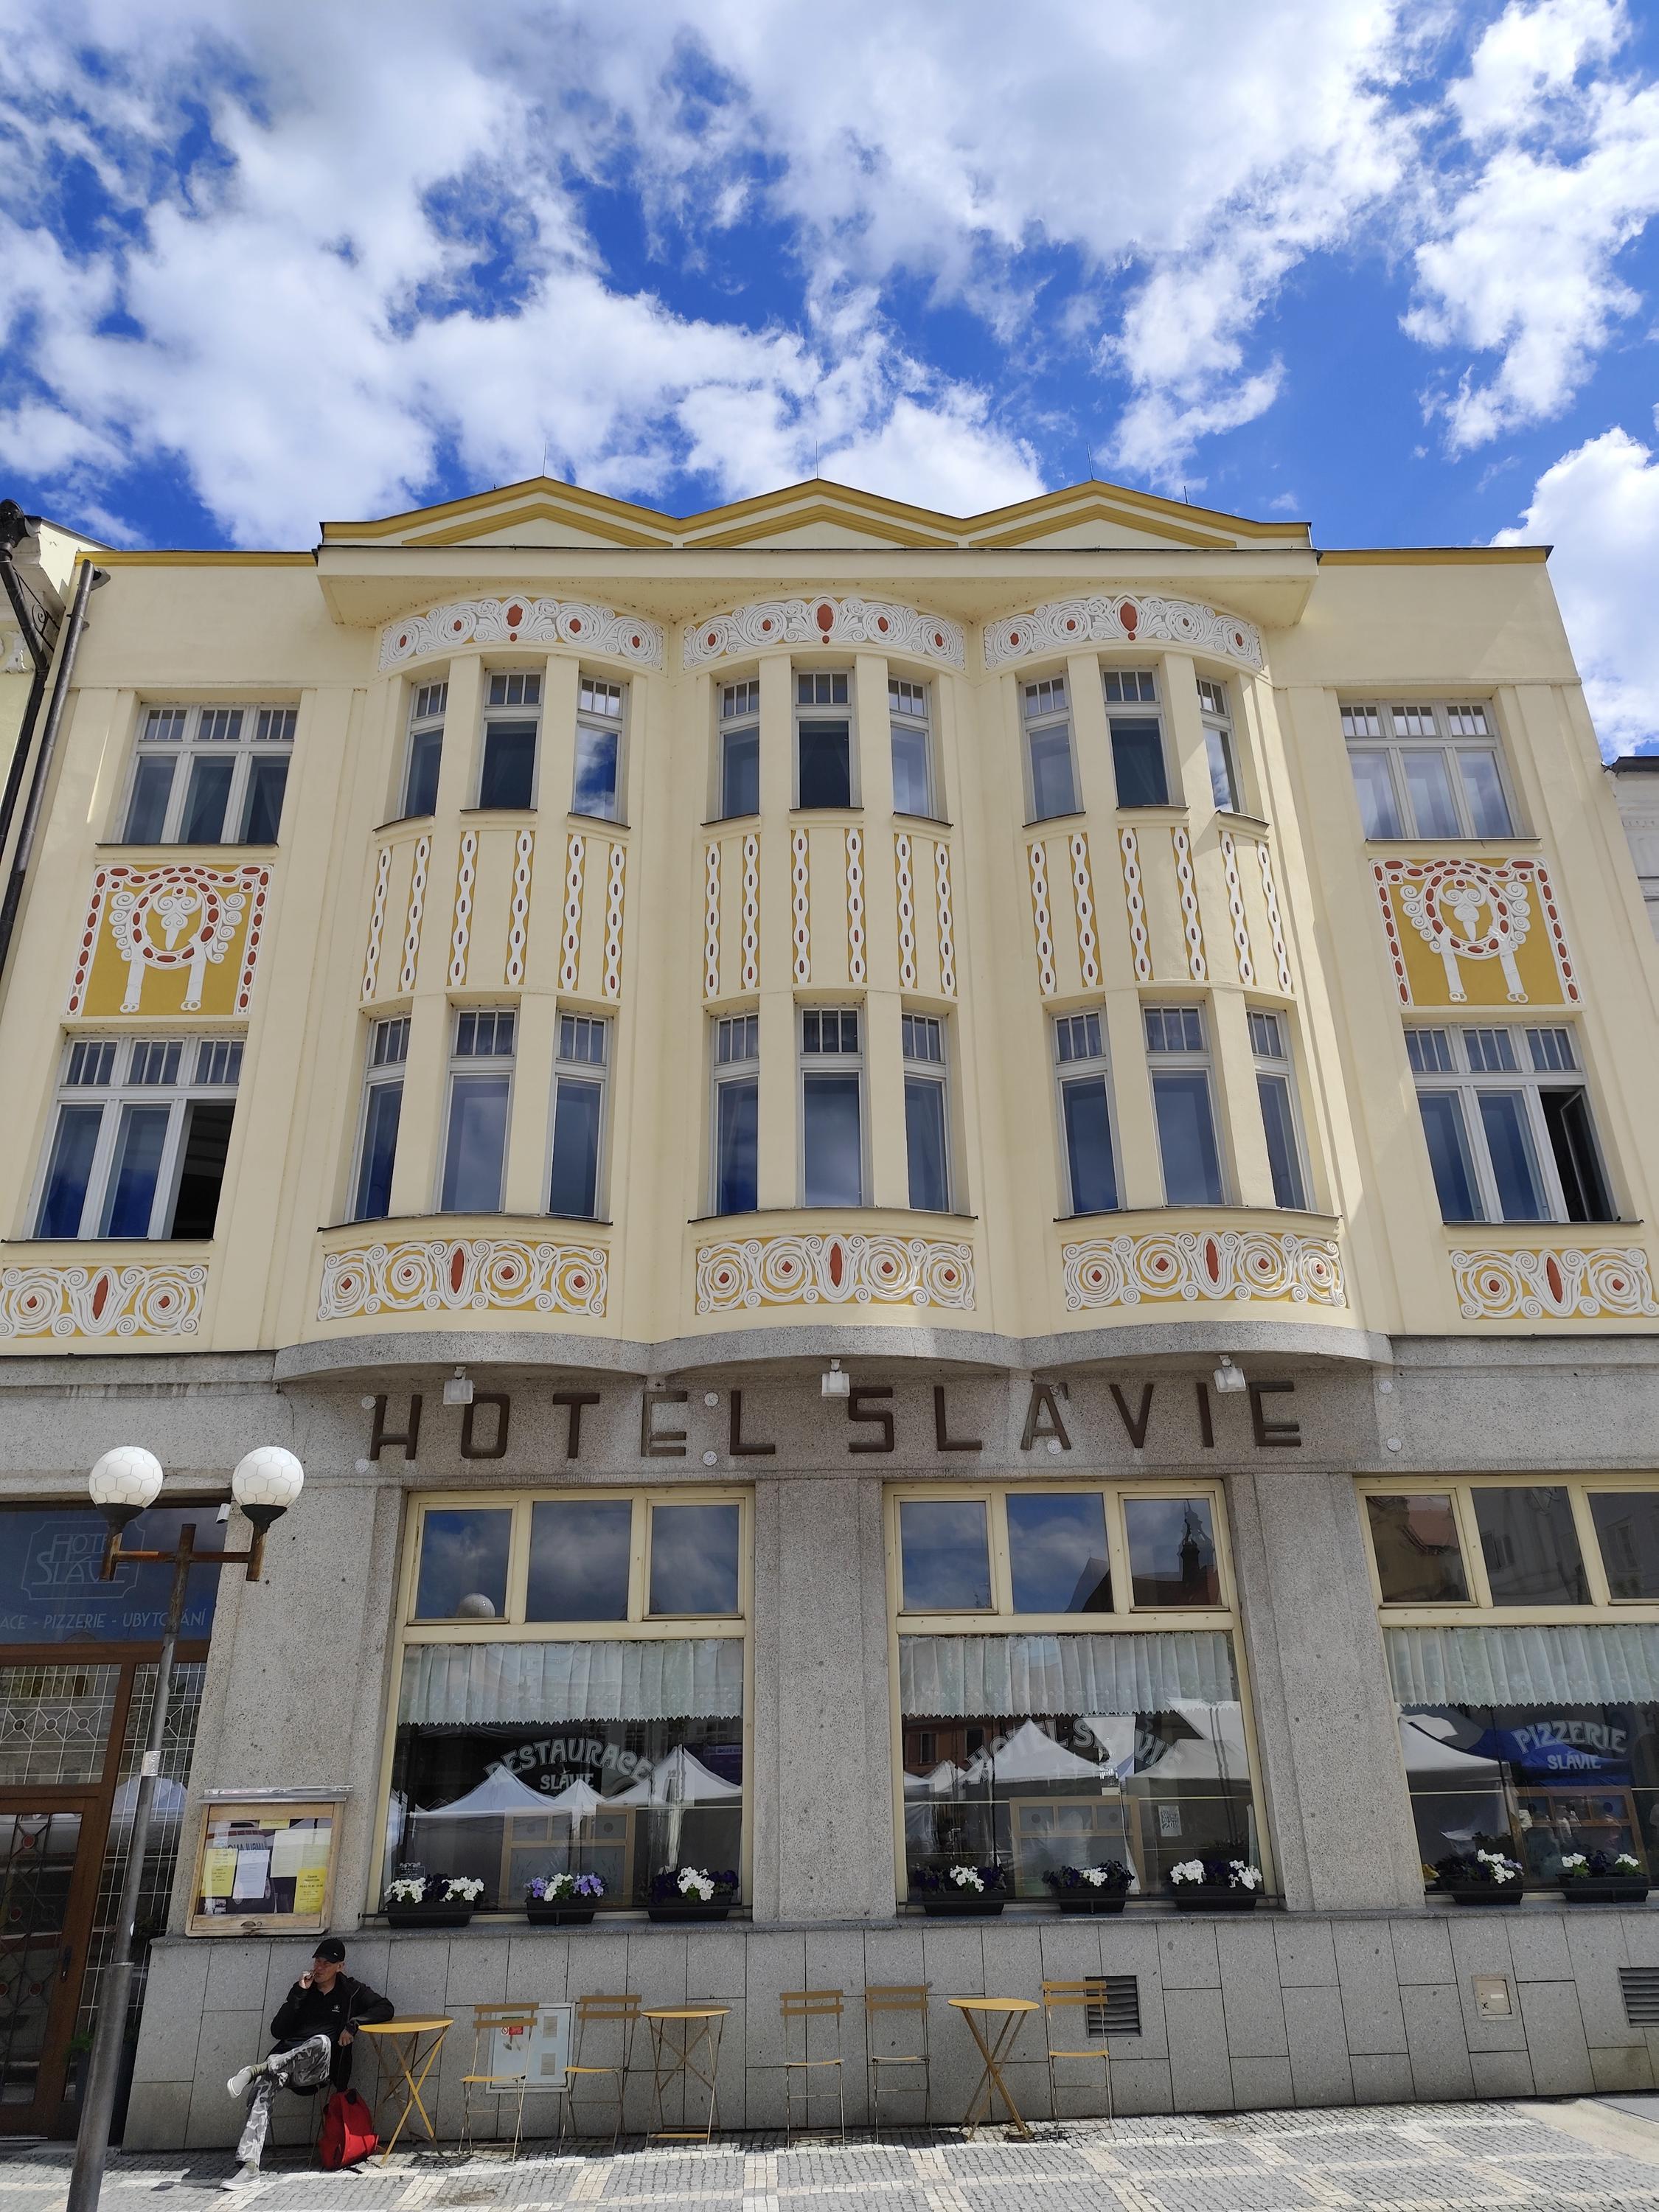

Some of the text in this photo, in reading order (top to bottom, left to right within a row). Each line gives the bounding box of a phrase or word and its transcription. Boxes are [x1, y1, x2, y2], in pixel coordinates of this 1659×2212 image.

[369, 1380, 1302, 1461] HOTEL SLÁVIE
[49, 1533, 108, 1562] HOT
[35, 1551, 130, 1584] SLÁVE
[44, 1613, 107, 1630] PIZZERIE
[123, 1607, 207, 1628] UBYTOÁNÍ
[1510, 1720, 1627, 1754] PIZZERIE
